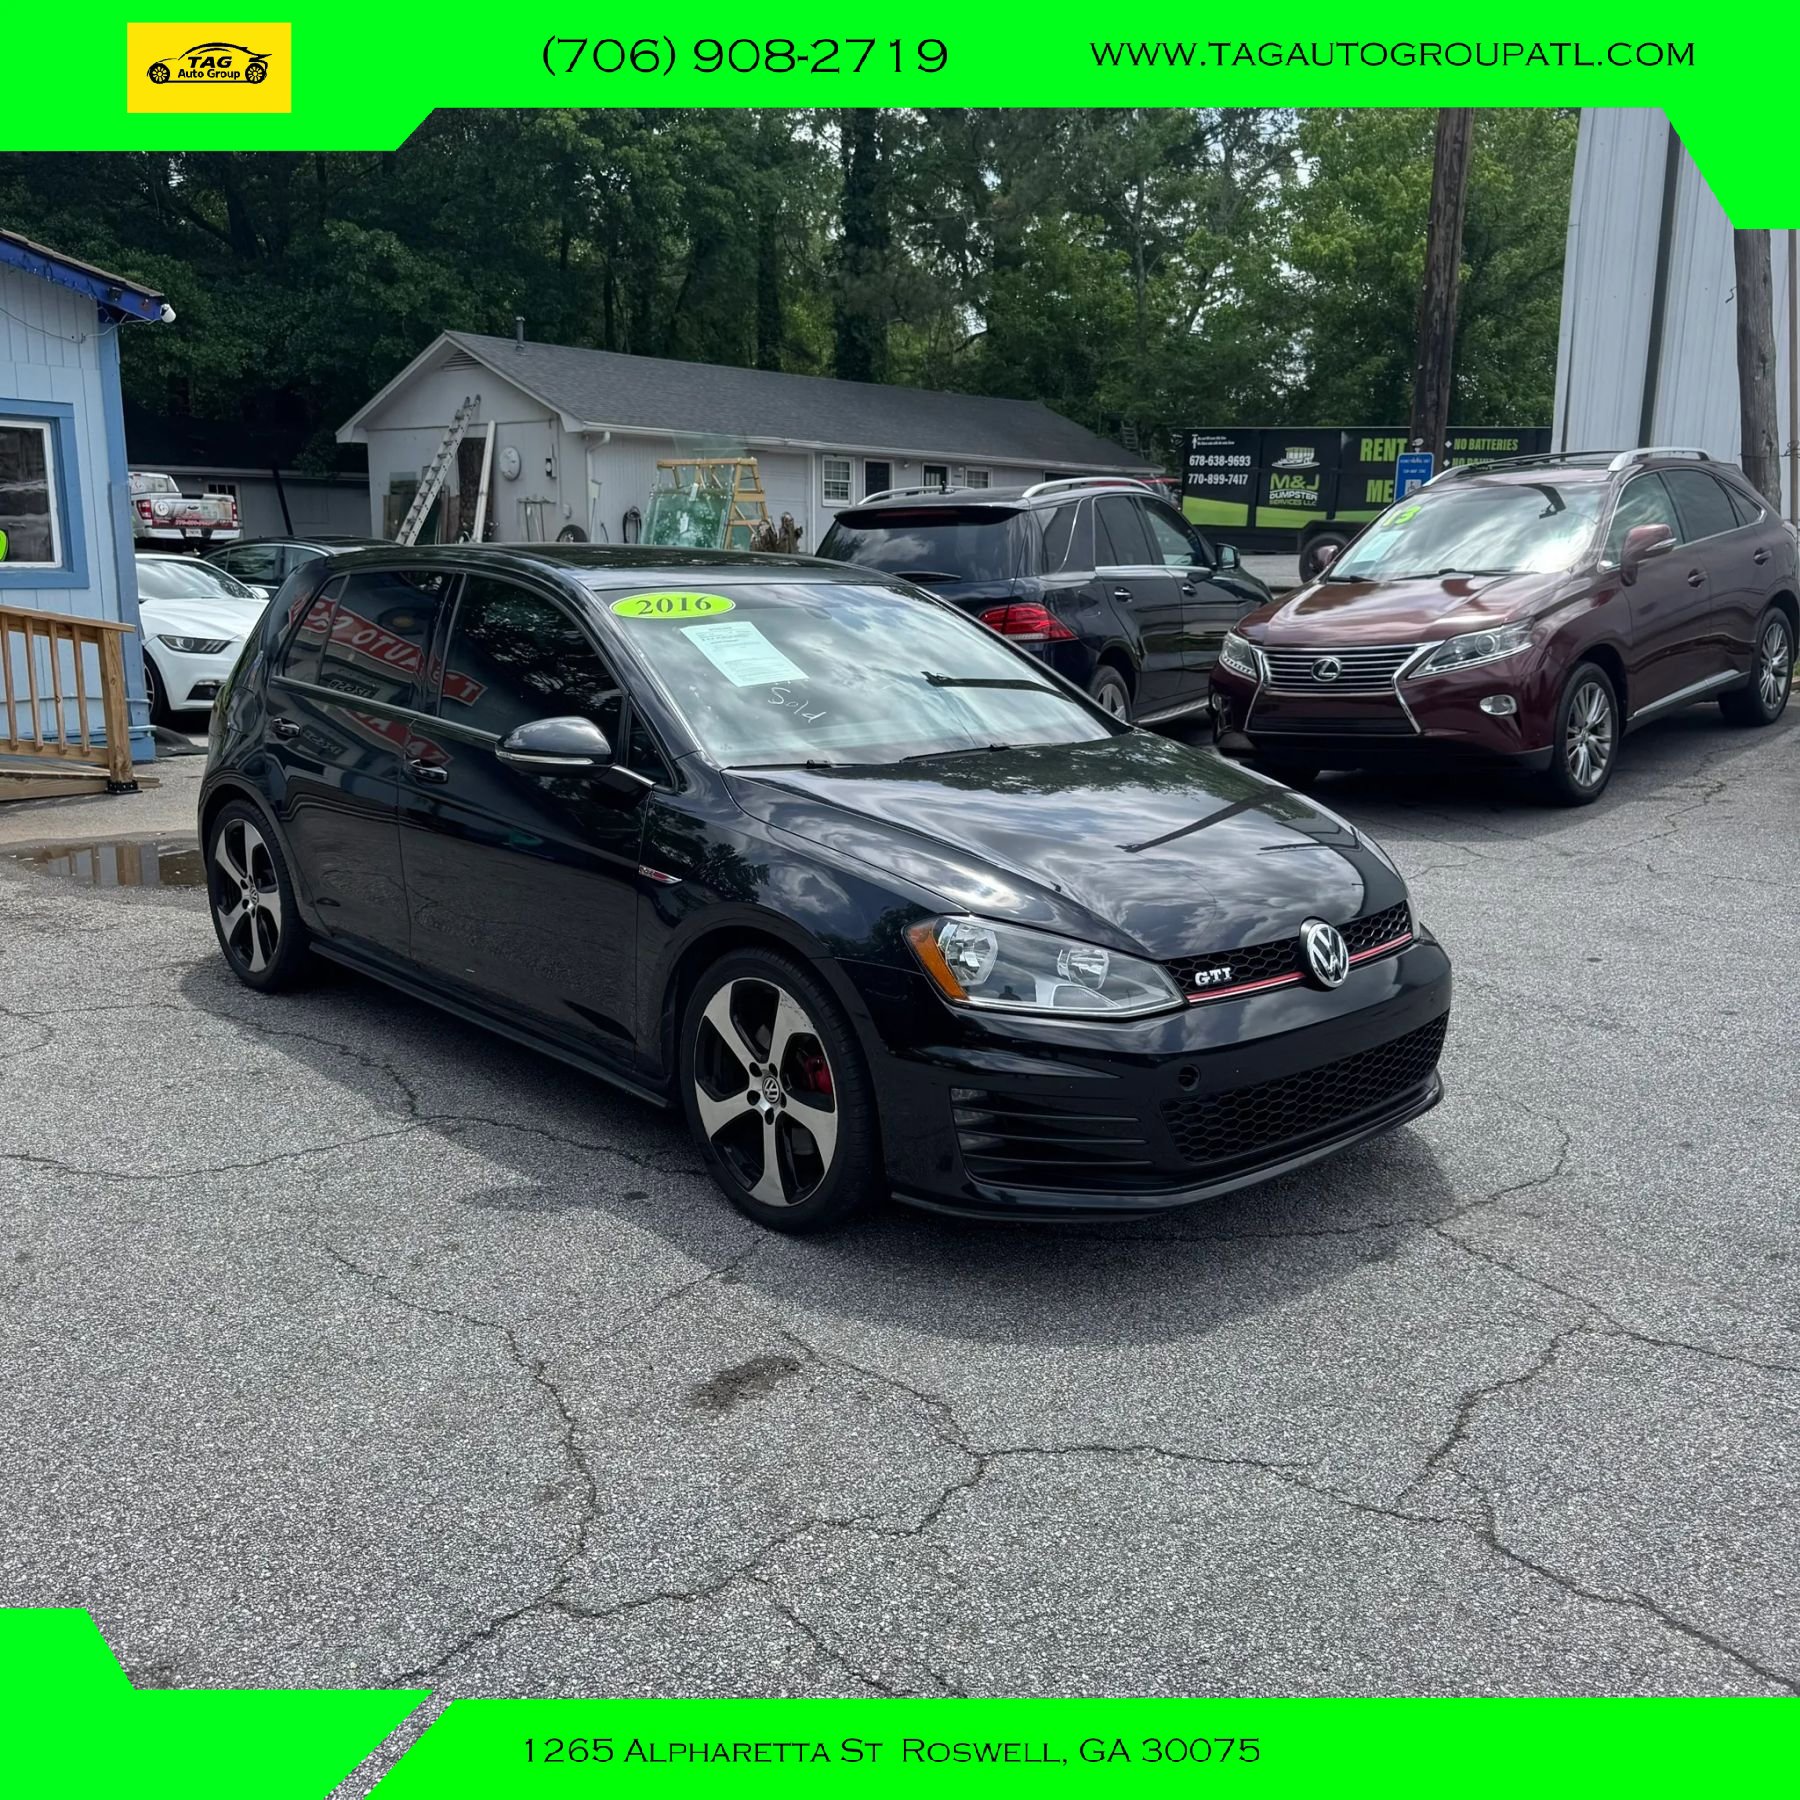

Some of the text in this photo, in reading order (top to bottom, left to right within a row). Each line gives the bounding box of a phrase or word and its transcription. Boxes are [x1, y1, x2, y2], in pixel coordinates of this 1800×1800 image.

[1360, 438, 1408, 462] RENT
[1454, 438, 1519, 451] NO BATTERIES
[1189, 455, 1251, 467] 678-638-9693
[1188, 473, 1249, 485] 770-899-7417
[1270, 473, 1320, 491] M&J
[1269, 490, 1318, 501] DUMPSTER
[1366, 479, 1395, 503] ME
[636, 596, 713, 615] 2016
[767, 686, 827, 724] Sold
[1194, 966, 1232, 986] GTI
